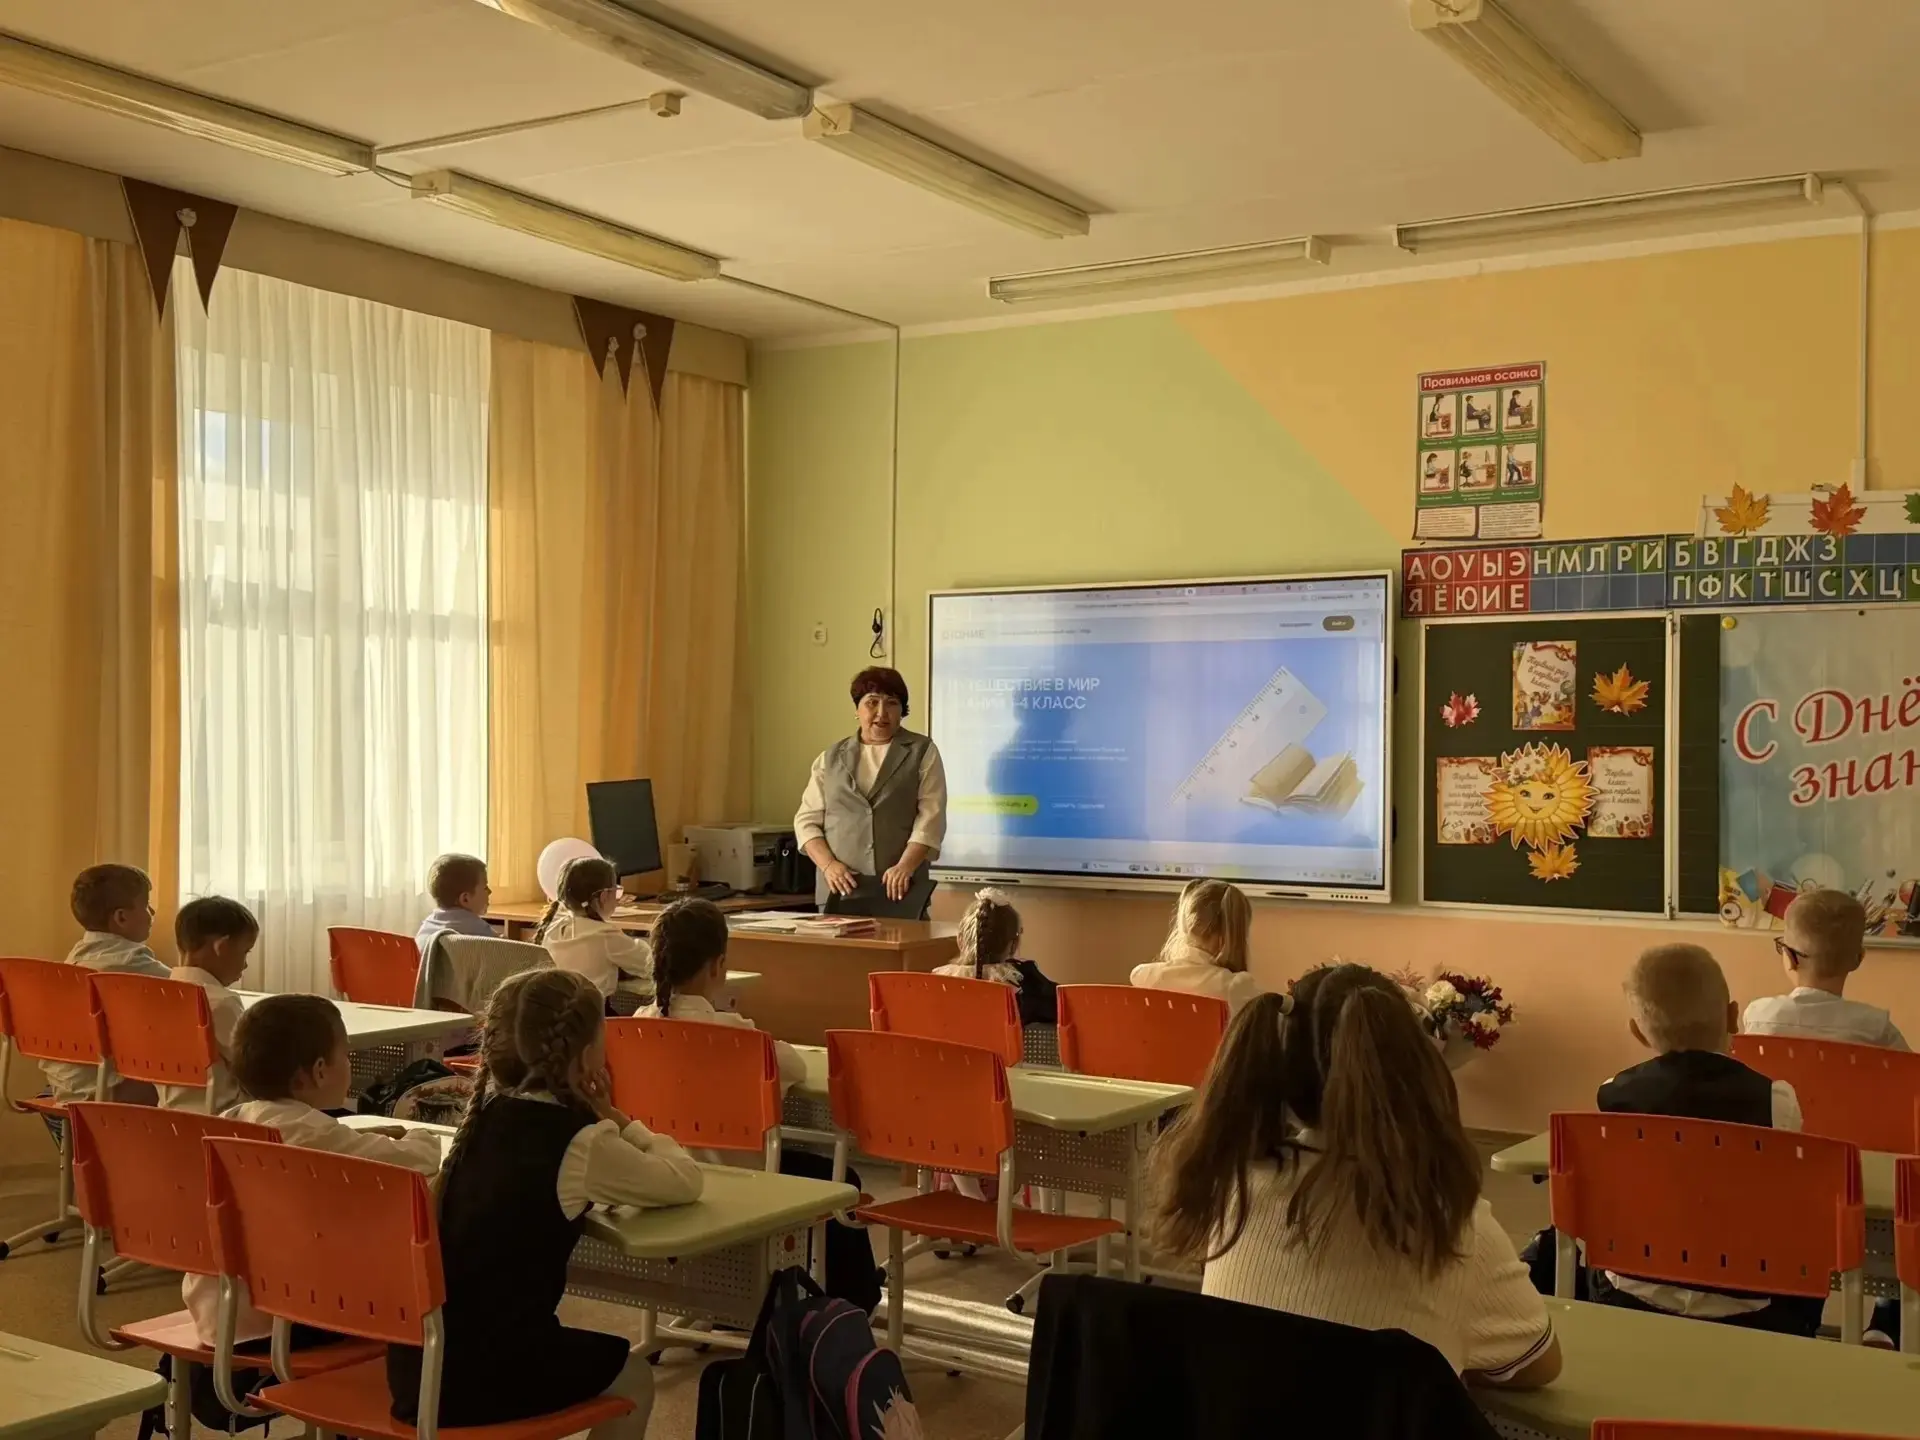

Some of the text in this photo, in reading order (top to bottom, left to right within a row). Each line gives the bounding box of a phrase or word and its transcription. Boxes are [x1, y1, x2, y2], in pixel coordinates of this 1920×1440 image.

[1424, 369, 1538, 389] Правильная осанка
[1408, 542, 1662, 580] А О У Ы Э Н М Л Р Й
[1675, 535, 1837, 566] Б В Г Д Ж З
[1408, 584, 1524, 612] Я Ё Ю И Е
[1673, 575, 1691, 600] П
[1698, 574, 1721, 599] Ф
[1729, 573, 1747, 598] К
[1760, 572, 1776, 597] Т
[1785, 570, 1810, 596] Ш
[1818, 570, 1836, 596] С
[1848, 570, 1868, 596] Х
[1880, 569, 1901, 599] Ц
[1055, 678, 1064, 690] В
[1068, 678, 1100, 691] МИР
[1032, 695, 1087, 710] КЛАСС
[1735, 701, 1777, 761] С
